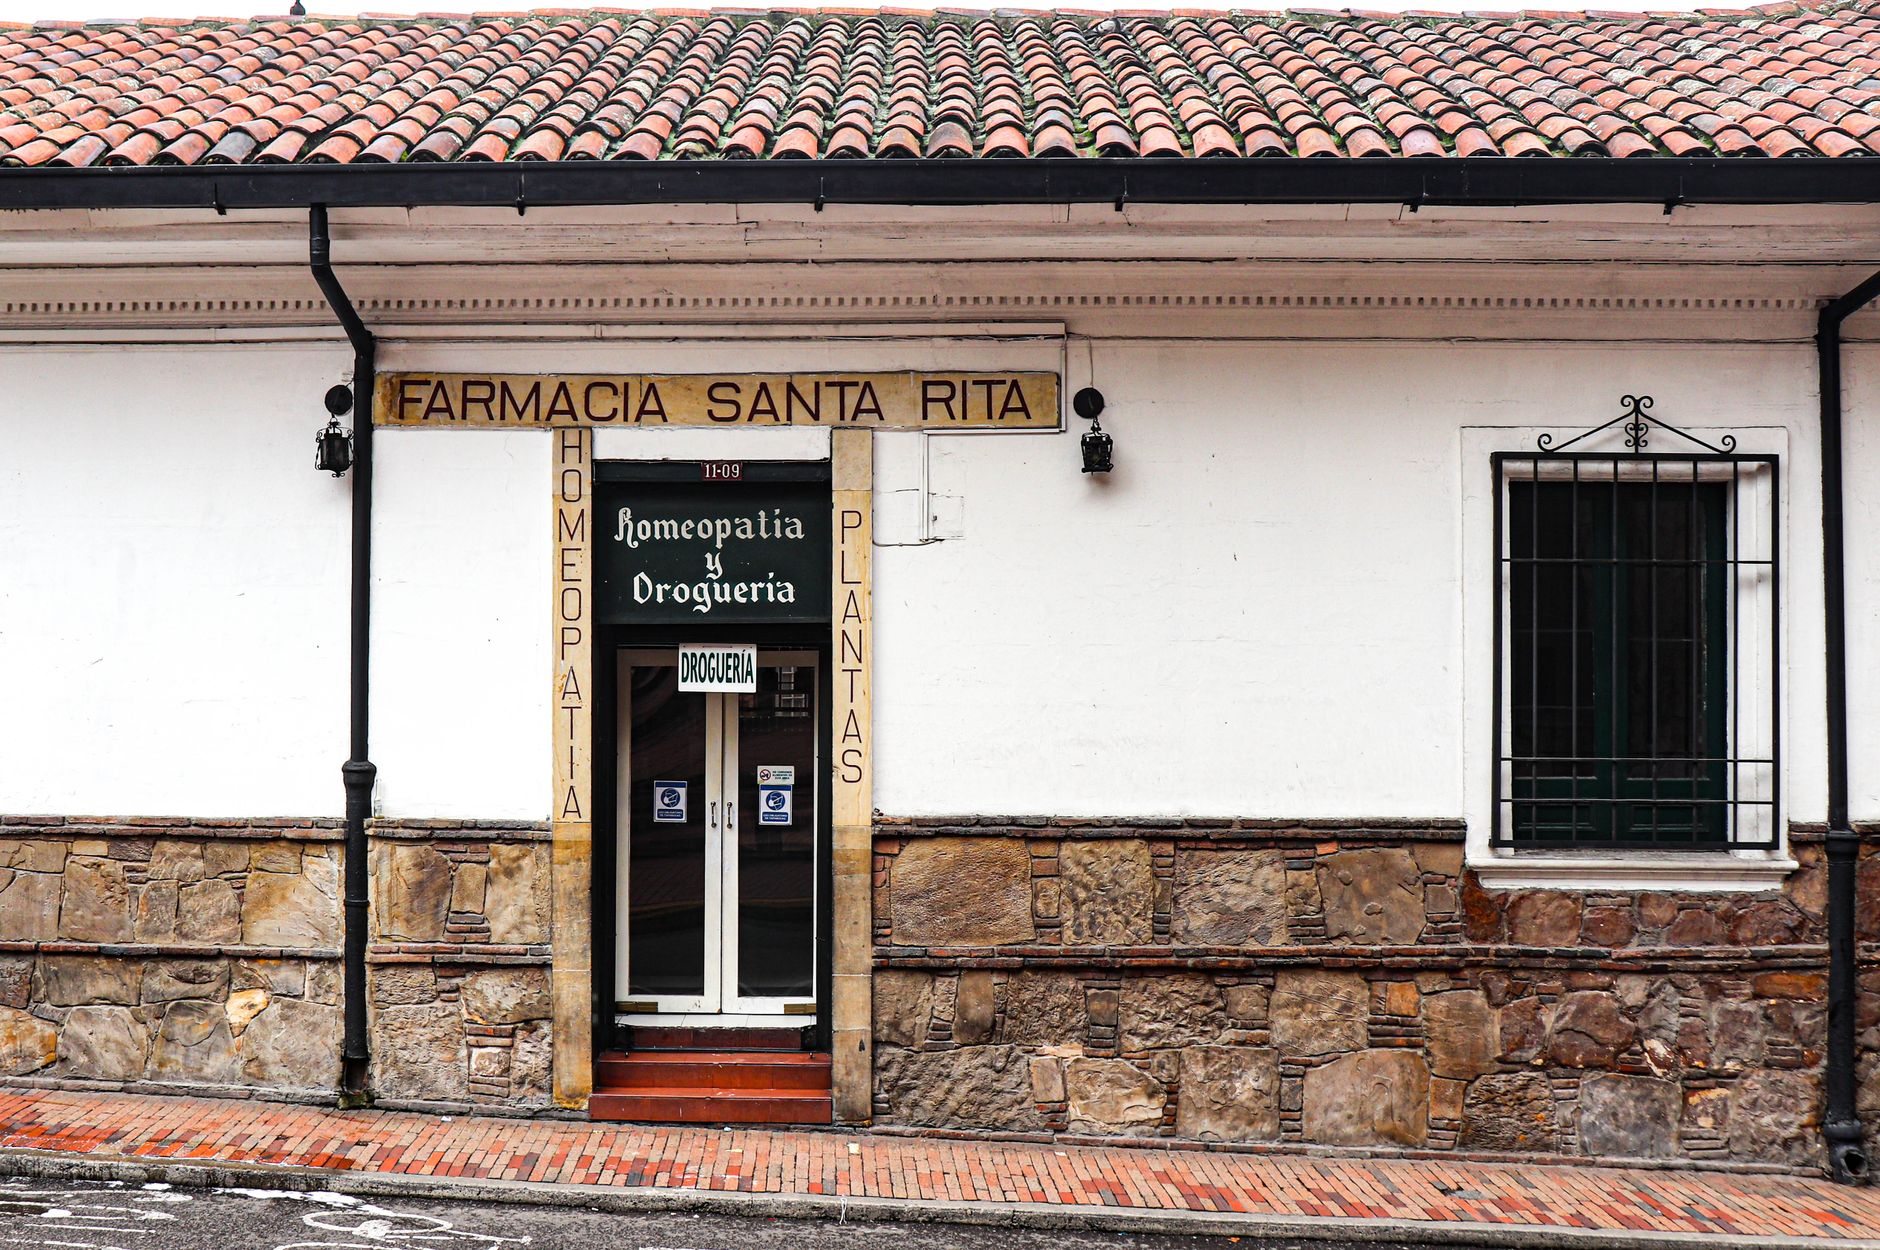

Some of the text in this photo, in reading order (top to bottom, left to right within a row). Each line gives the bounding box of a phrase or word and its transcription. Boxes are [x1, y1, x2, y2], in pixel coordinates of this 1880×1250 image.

[399, 379, 1032, 423] FARMACIA SANTA RITA
[704, 463, 740, 478] 11-09
[704, 552, 723, 580] y
[558, 429, 585, 819] HOMEOPATIA
[841, 510, 862, 783] PLANTAS
[681, 649, 754, 684] DROGUERÍA
